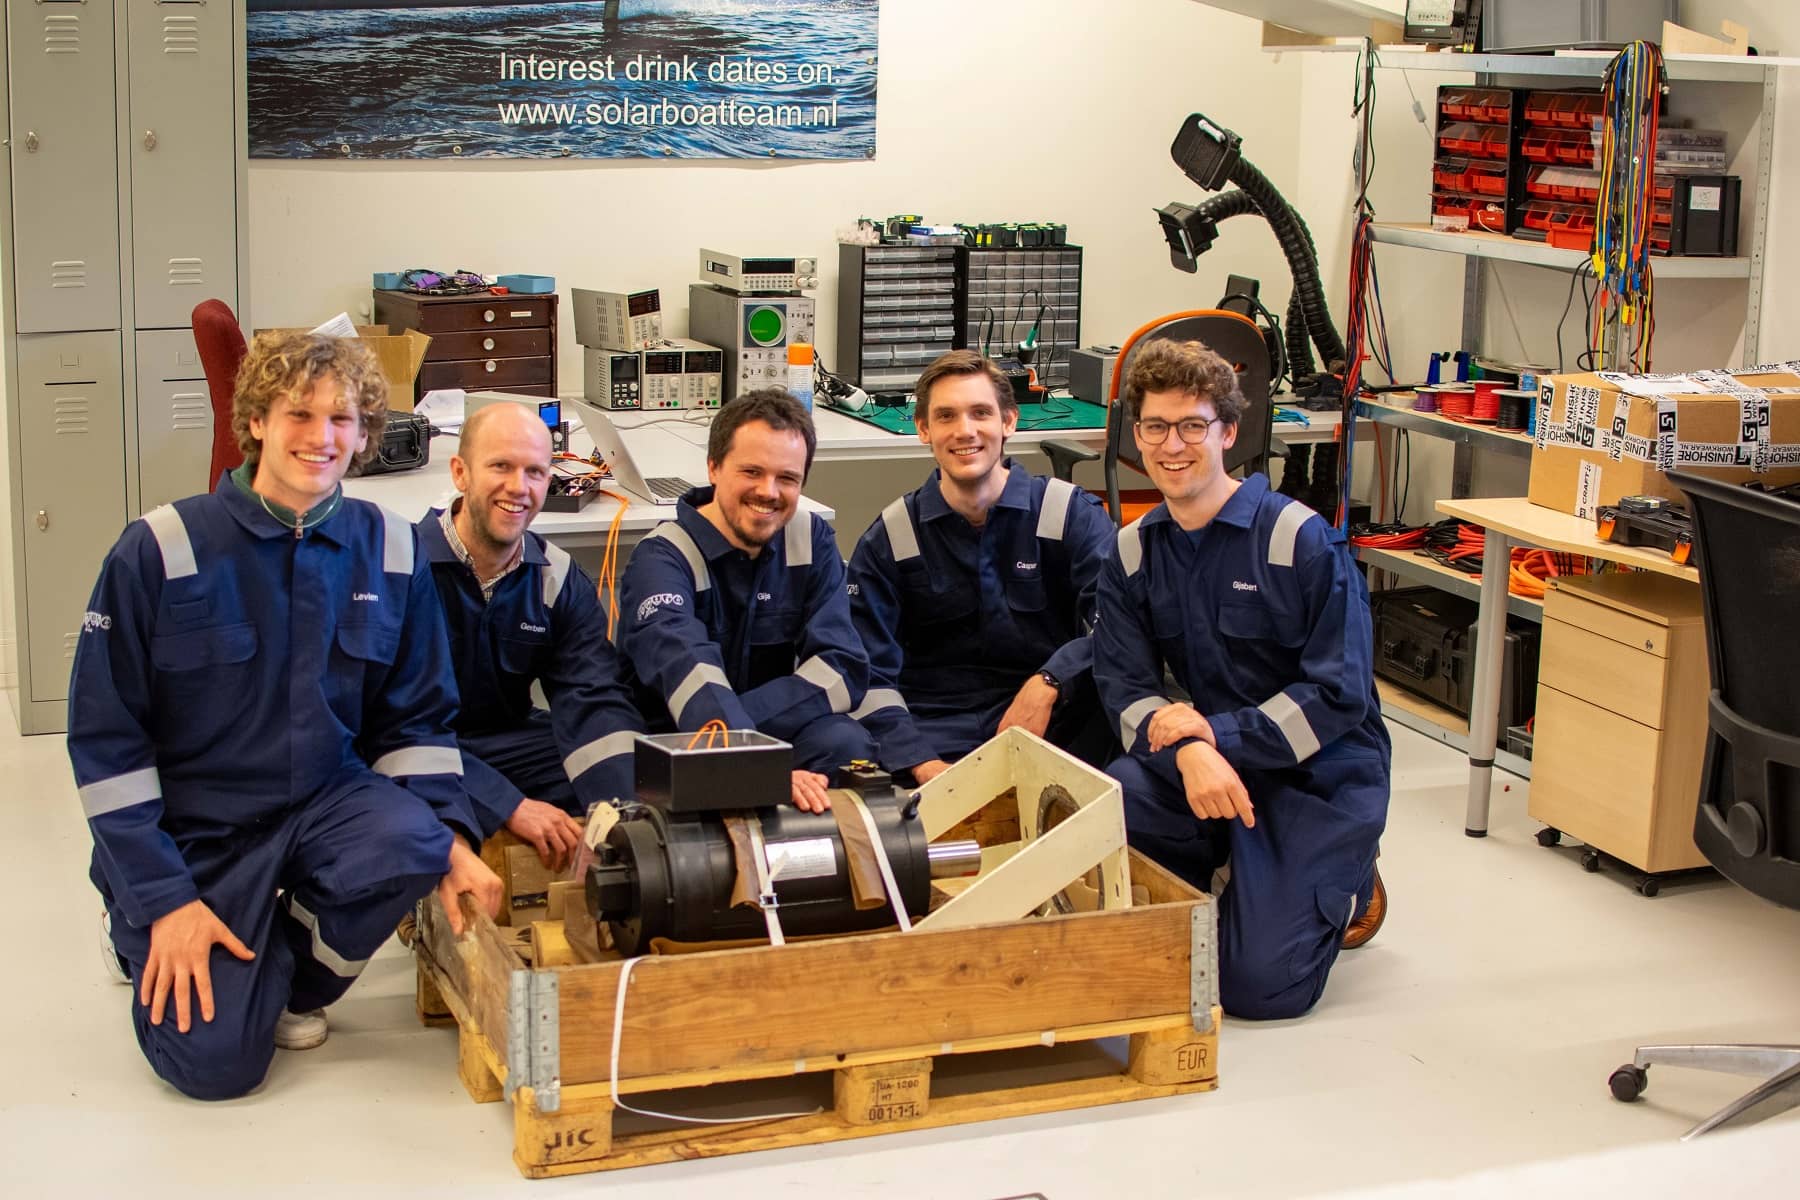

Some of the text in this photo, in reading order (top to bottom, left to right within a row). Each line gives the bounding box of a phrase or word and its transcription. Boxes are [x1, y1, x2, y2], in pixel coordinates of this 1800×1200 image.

[500, 52, 841, 84] Interest drink dates on:
[498, 96, 838, 127] www.solarboatteam.nl
[1679, 450, 1735, 463] UNISHORE
[1177, 1048, 1208, 1071] EUR
